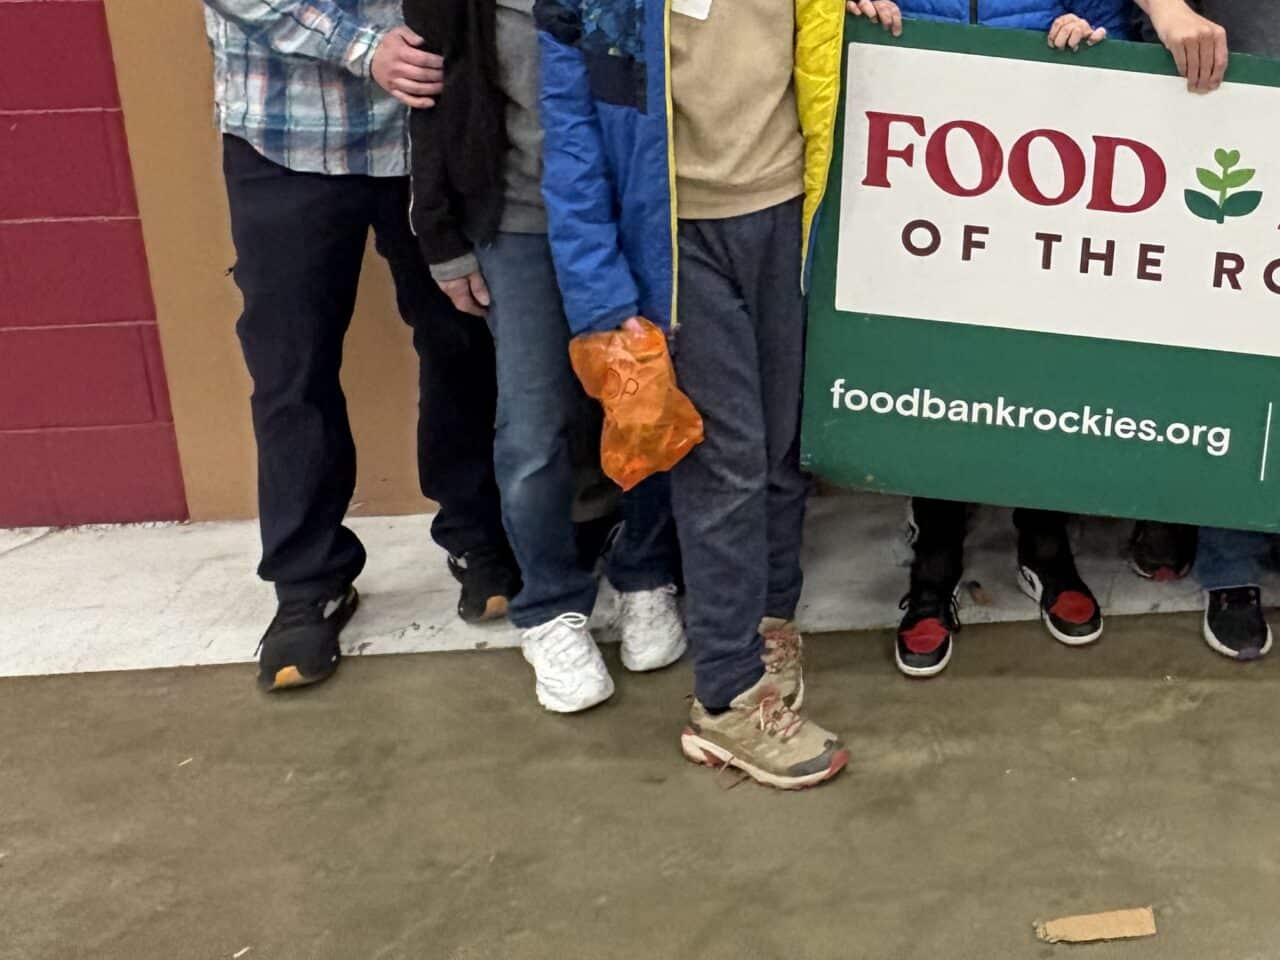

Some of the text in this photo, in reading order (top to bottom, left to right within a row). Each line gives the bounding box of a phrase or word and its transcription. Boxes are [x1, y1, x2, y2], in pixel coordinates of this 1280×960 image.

[861, 111, 1167, 213] FOOD
[901, 219, 990, 261] OF
[1034, 232, 1166, 282] THE
[829, 378, 1232, 456] foodbankrockies.org
